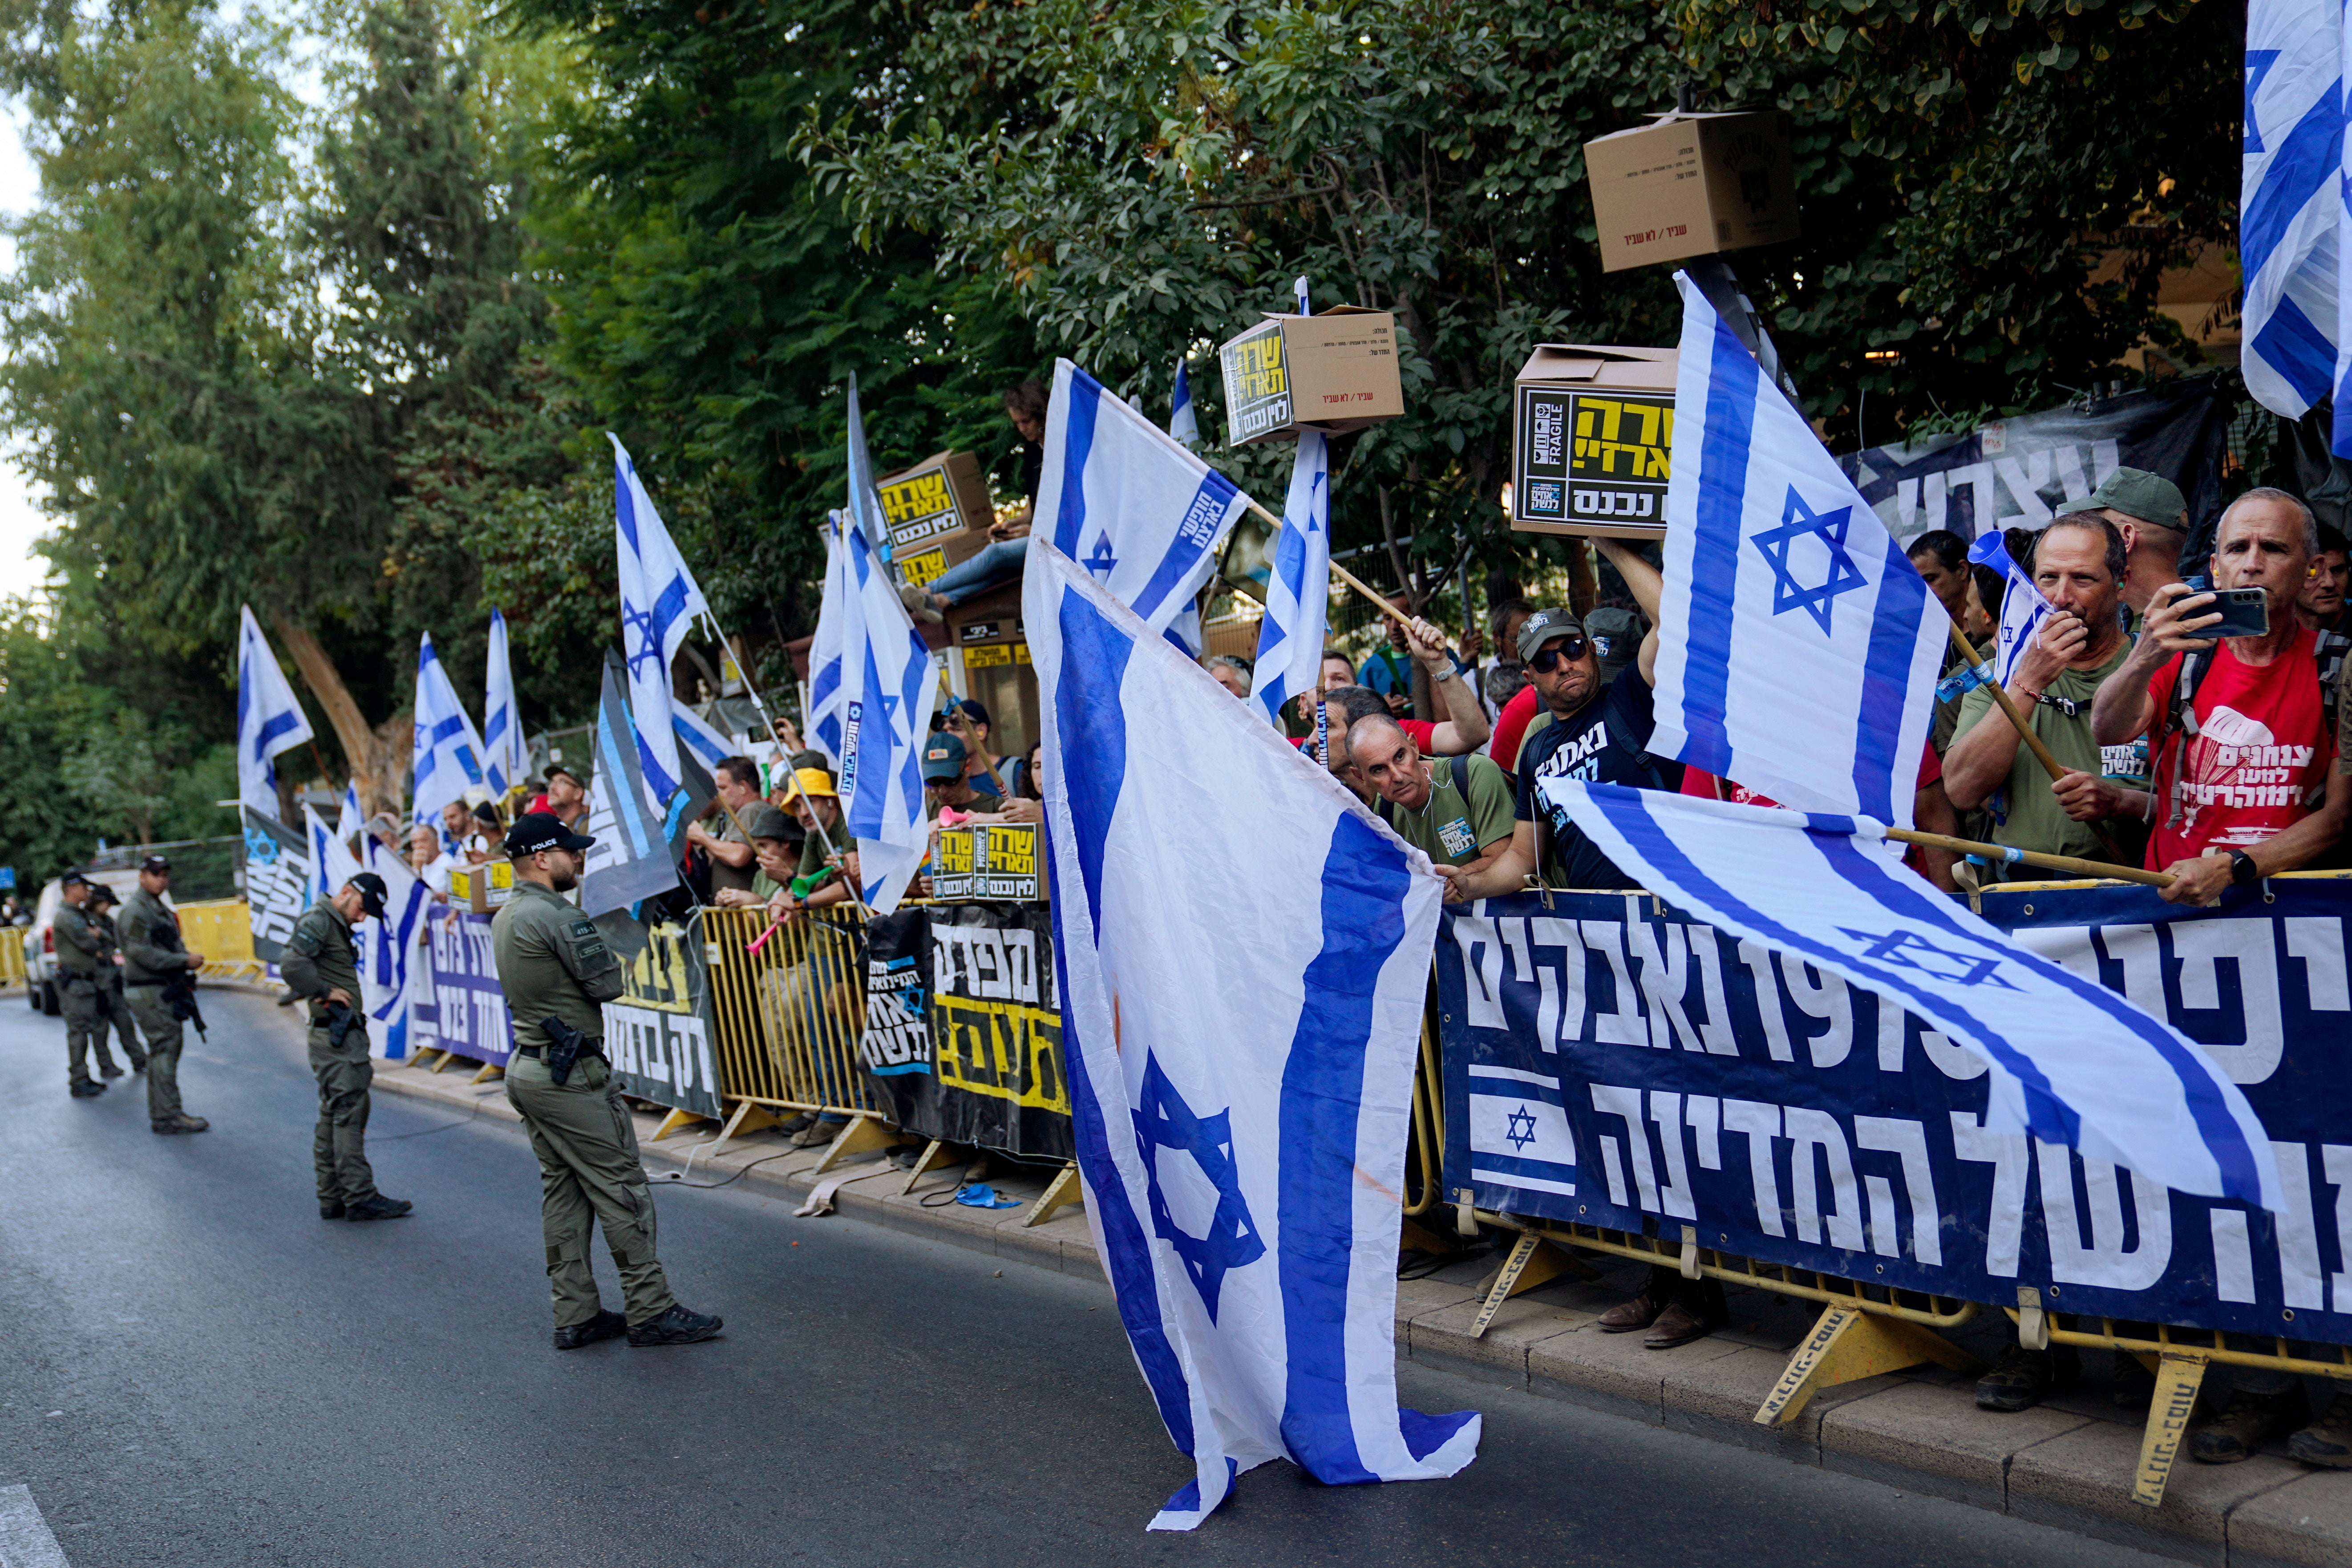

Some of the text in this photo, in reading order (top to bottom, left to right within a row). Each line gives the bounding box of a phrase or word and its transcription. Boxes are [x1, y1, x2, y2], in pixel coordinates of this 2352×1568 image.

[1624, 231, 1643, 246] שביר
[1646, 229, 1656, 242] לא
[1668, 224, 1687, 238] שביר
[1235, 336, 1281, 375] שרה
[1323, 394, 1339, 403] שביר
[1340, 393, 1348, 402] לא
[1357, 392, 1373, 401] שביר
[1243, 409, 1266, 433] נכנס
[1267, 399, 1287, 427] לוין
[1549, 404, 1563, 465] FRAGILE
[1572, 438, 1671, 479] ארזי!
[879, 473, 944, 508] שרה
[1531, 490, 1552, 500] אחים
[1180, 491, 1212, 538] חופשי
[1531, 498, 1559, 509] לנשק
[1573, 490, 1653, 517] נכנס
[894, 511, 957, 544] לוין נכנס
[1191, 500, 1225, 548] בארצנו
[2100, 745, 2135, 760] אחים
[2217, 745, 2314, 767] צנחנים
[2101, 758, 2146, 776] לנשק
[2238, 767, 2289, 784] למען
[531, 838, 557, 852] POLICE
[988, 826, 1034, 855] שרה
[1440, 830, 1465, 846] אחים
[1445, 833, 1476, 858] לנשק
[989, 880, 1015, 895] נכנס
[1016, 879, 1035, 897] לוין
[1453, 916, 1740, 1057] נאבקים
[1589, 1083, 1942, 1266] המדינה
[1766, 1313, 1844, 1412] אירגוני-במות
